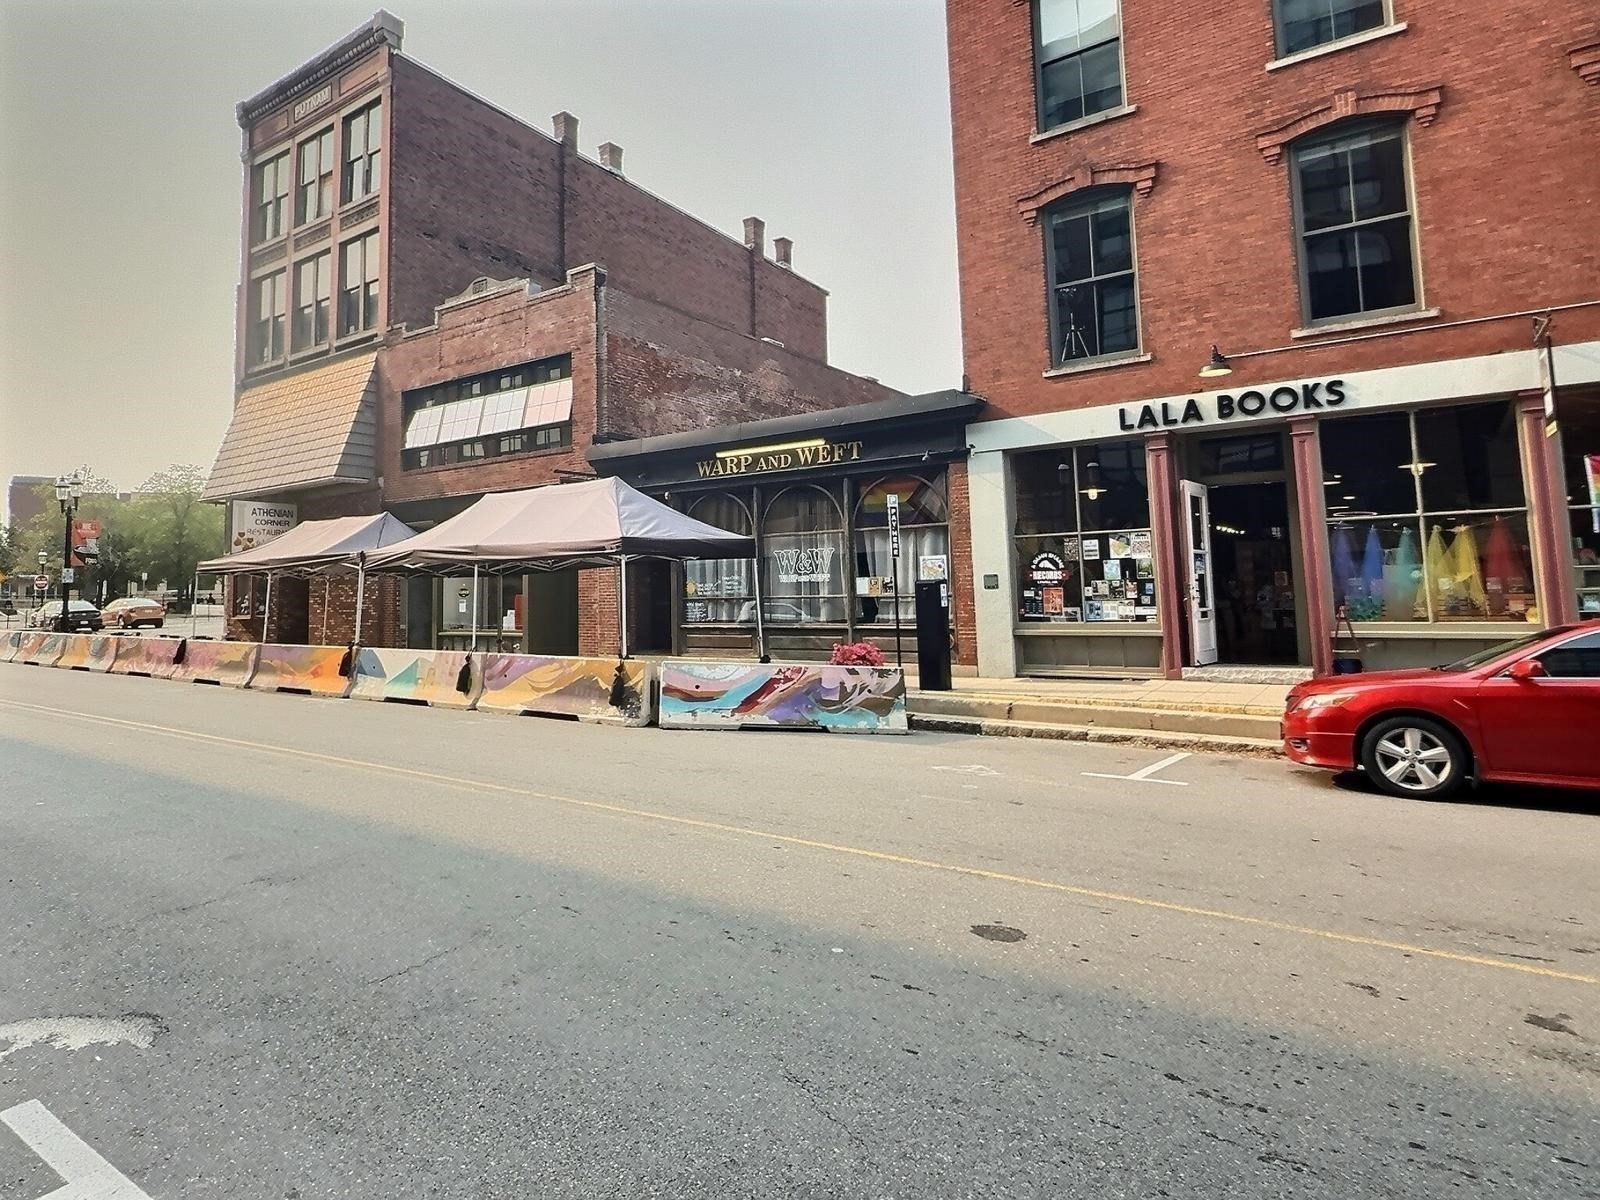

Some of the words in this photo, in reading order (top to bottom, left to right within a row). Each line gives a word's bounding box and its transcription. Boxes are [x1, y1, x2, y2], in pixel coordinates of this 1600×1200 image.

[295, 87, 329, 118] PUTNAM
[1119, 398, 1203, 430] LALA
[1217, 380, 1345, 419] BOOKS
[696, 455, 752, 477] WARP
[756, 454, 792, 471] AND
[796, 441, 863, 464] WEFT
[251, 507, 294, 518] ATHENIAN
[247, 528, 288, 536] RESTAURA
[254, 518, 290, 527] CORNER
[773, 547, 835, 574] W&W
[1032, 570, 1063, 580] RECORDS
